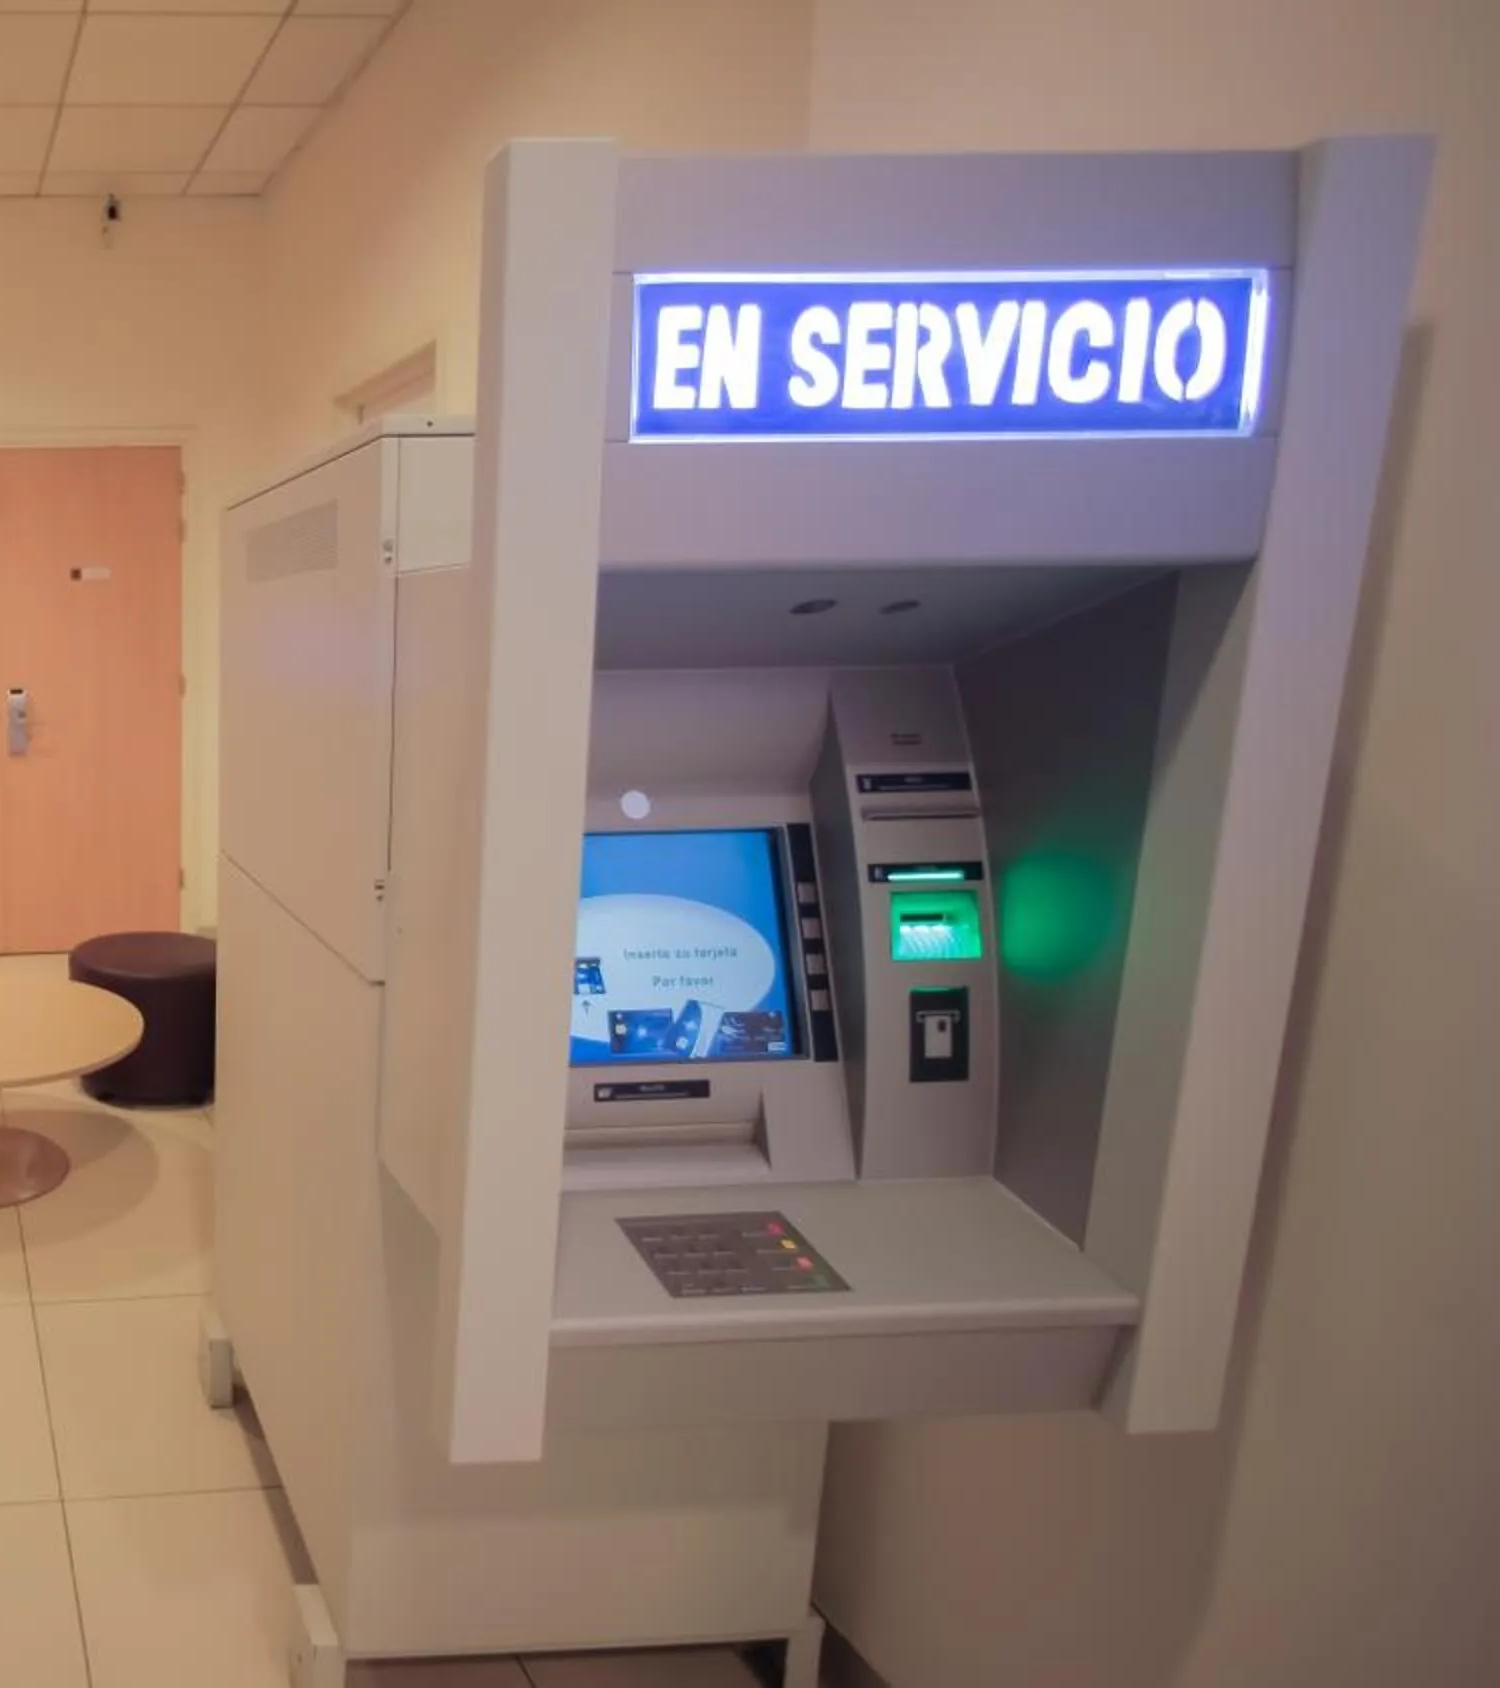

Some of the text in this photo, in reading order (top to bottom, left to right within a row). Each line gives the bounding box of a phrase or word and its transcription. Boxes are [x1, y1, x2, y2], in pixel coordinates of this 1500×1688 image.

[653, 298, 1227, 409] EN SERVICIO
[694, 946, 738, 961] tarjeta
[652, 974, 714, 987] Por favor
